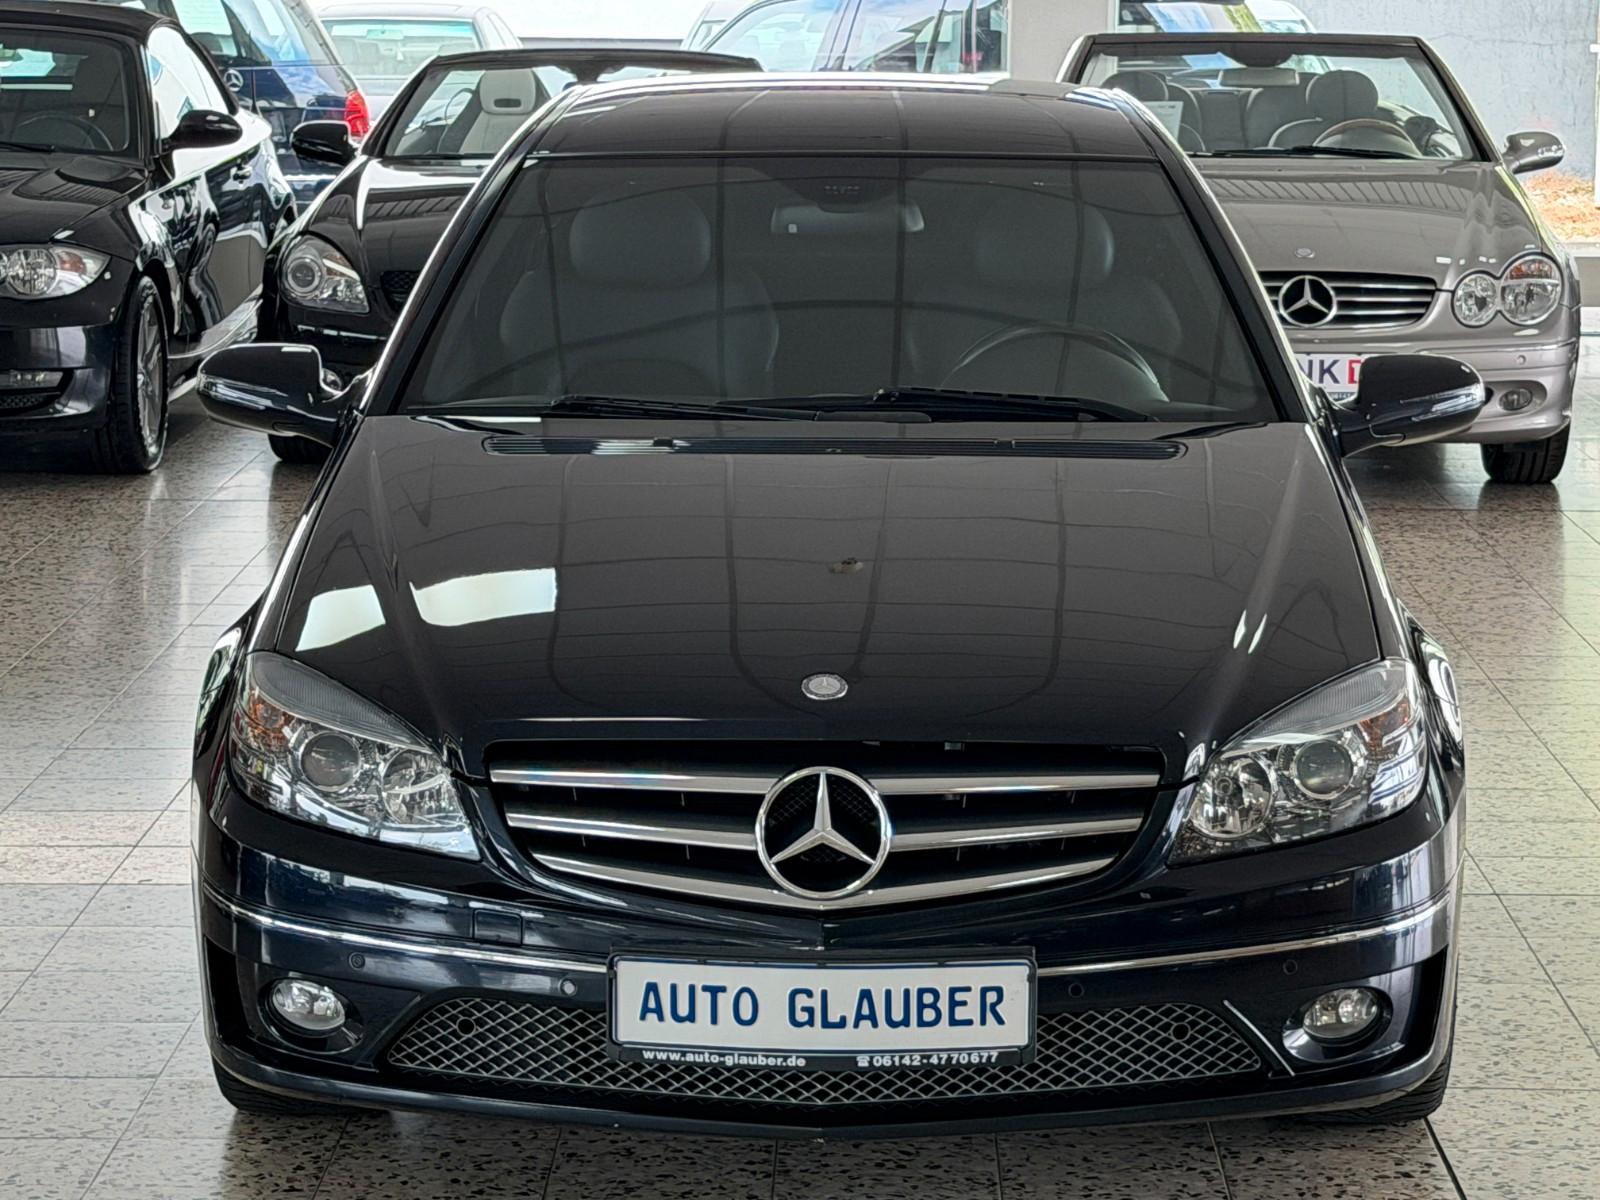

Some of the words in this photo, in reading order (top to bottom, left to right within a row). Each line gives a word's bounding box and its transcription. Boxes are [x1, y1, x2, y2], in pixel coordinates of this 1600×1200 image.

[639, 981, 759, 1027] AUTO
[787, 985, 1006, 1030] GLAUBER
[642, 1050, 807, 1068] www.auto-glauber.de
